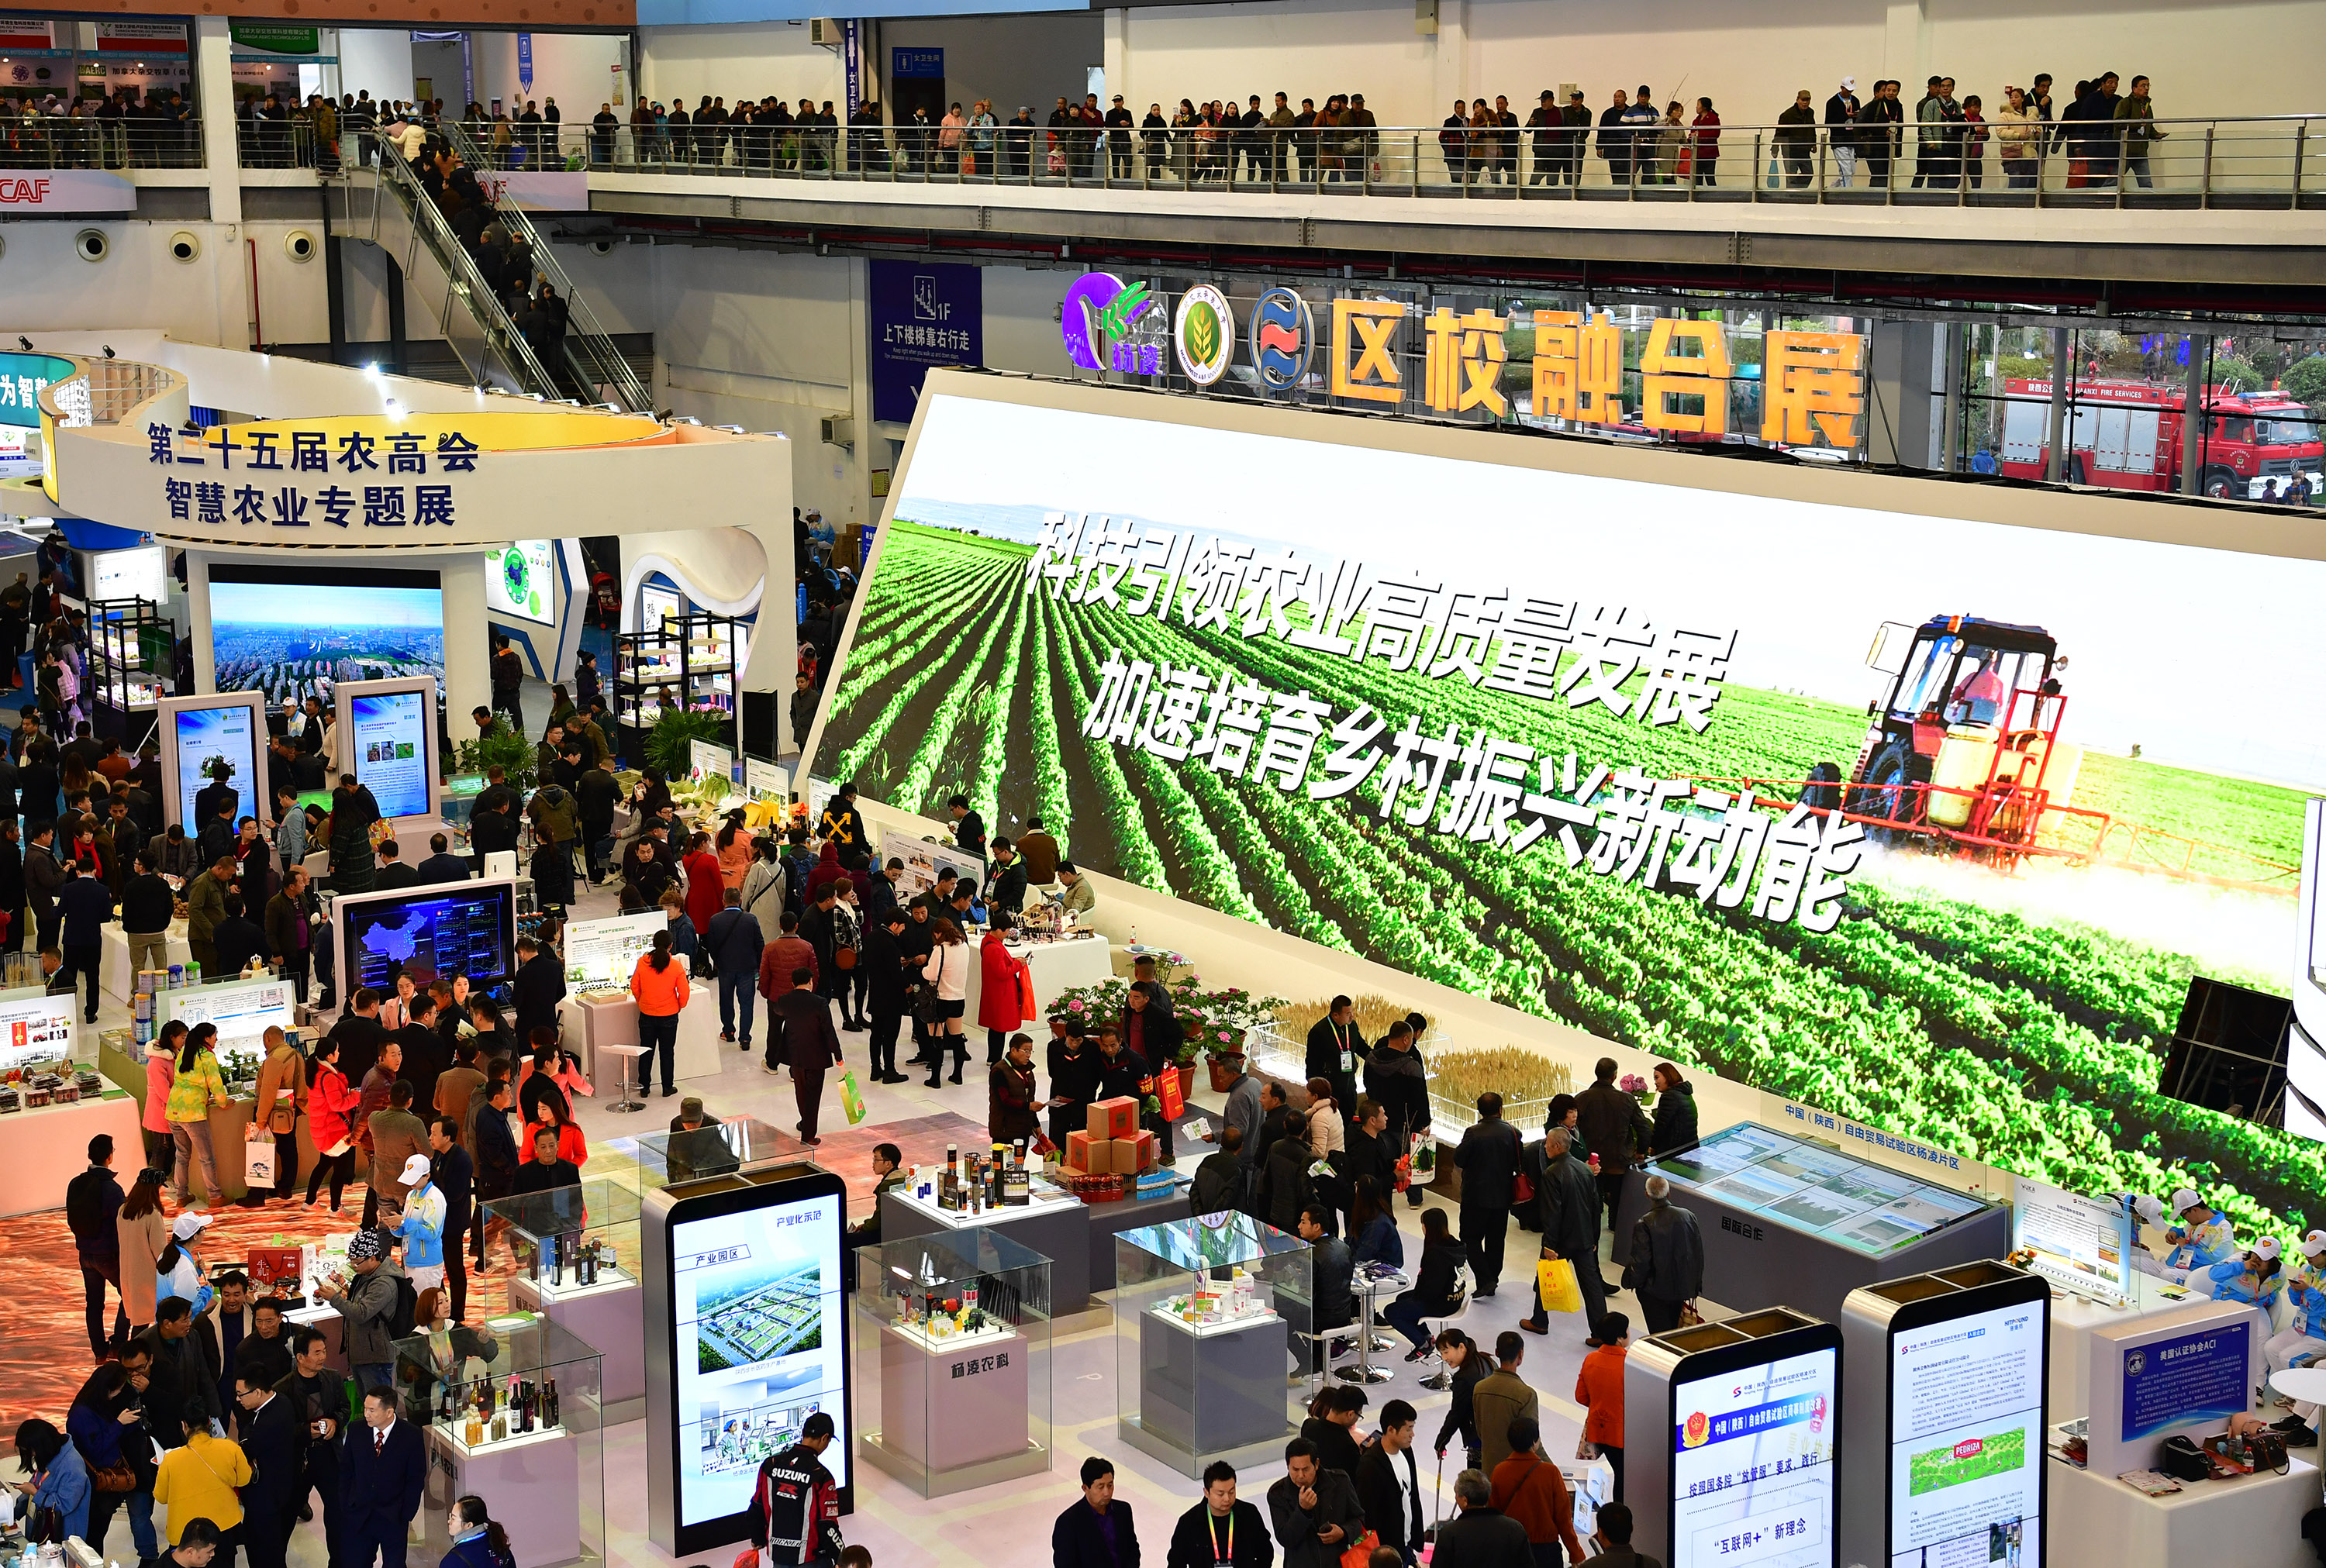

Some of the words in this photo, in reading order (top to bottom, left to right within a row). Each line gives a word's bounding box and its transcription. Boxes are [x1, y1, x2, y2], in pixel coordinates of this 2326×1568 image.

[937, 303, 951, 321] 1F
[883, 323, 969, 351] 上下楼梯靠右行走
[1331, 298, 1865, 447] 区校融合展
[2114, 390, 2142, 398] SERVICES
[147, 421, 479, 475] 第二十五届农高会
[165, 476, 456, 528] 智慧农业专题展
[1026, 510, 1738, 735] 科技引领农业高质量发展
[1082, 648, 1865, 934] 加速培育乡村振兴新动能
[1785, 1104, 1959, 1171] 中国（陕西）自由贸易试验区杨凌片区
[777, 1210, 822, 1228] 产业化示范
[1720, 1215, 1764, 1242] 国际合作
[695, 1248, 738, 1266] 产业园区
[2159, 1339, 2217, 1361] 美国认证协会ACI
[951, 1352, 1009, 1379] 杨凌农科
[1955, 1442, 1980, 1456] PEDRIZA
[771, 1467, 811, 1484] SUZUKI
